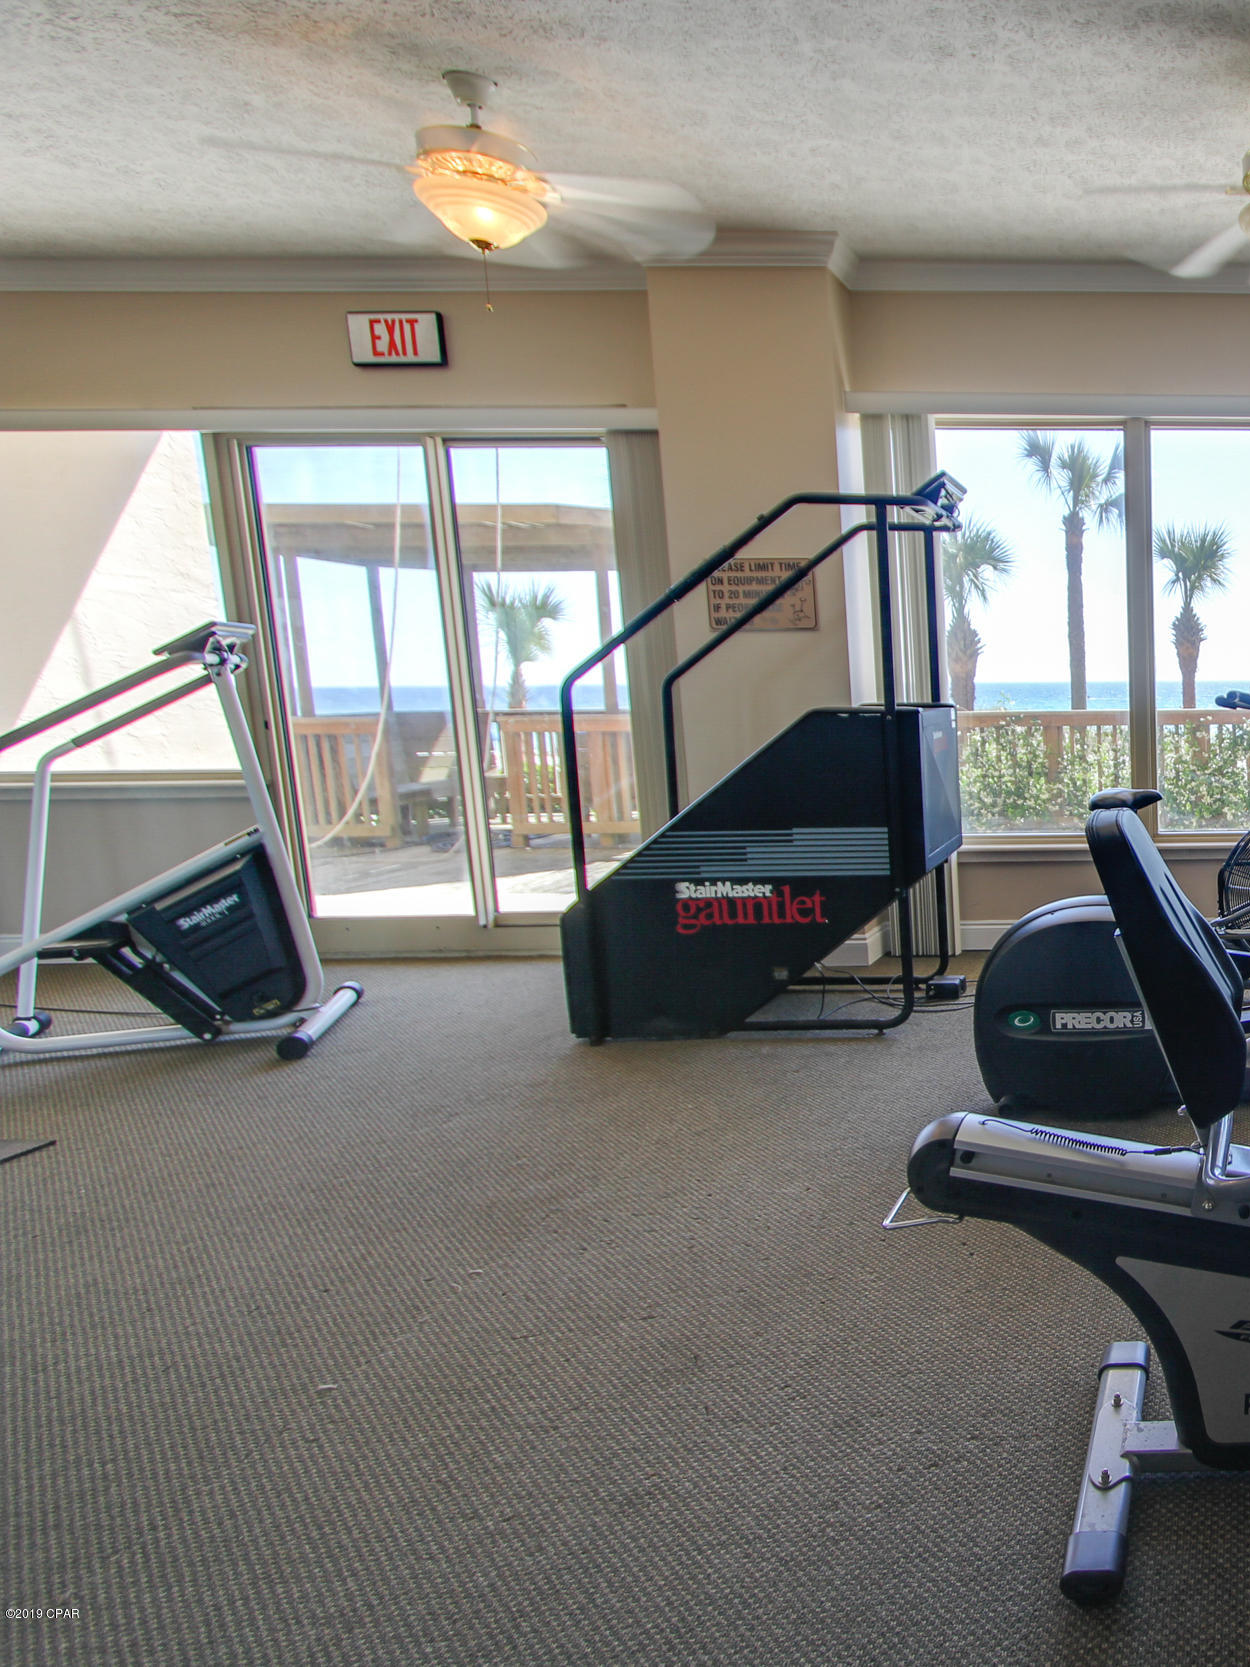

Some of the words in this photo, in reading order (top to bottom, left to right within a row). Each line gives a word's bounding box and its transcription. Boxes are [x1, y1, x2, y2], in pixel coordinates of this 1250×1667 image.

[368, 318, 419, 357] EXIT
[716, 562, 745, 572] EASE
[748, 562, 775, 572] LIMIT
[710, 575, 724, 586] ON
[727, 576, 782, 586] EQUIPMENT
[712, 589, 724, 599] TO
[728, 589, 740, 599] 20
[713, 603, 722, 613] IF
[675, 881, 773, 898] StairMaster
[176, 892, 241, 931] StairMaster
[676, 884, 828, 935] gauntlet
[1055, 1012, 1133, 1029] PRECOR
[1132, 1010, 1142, 1028] USA
